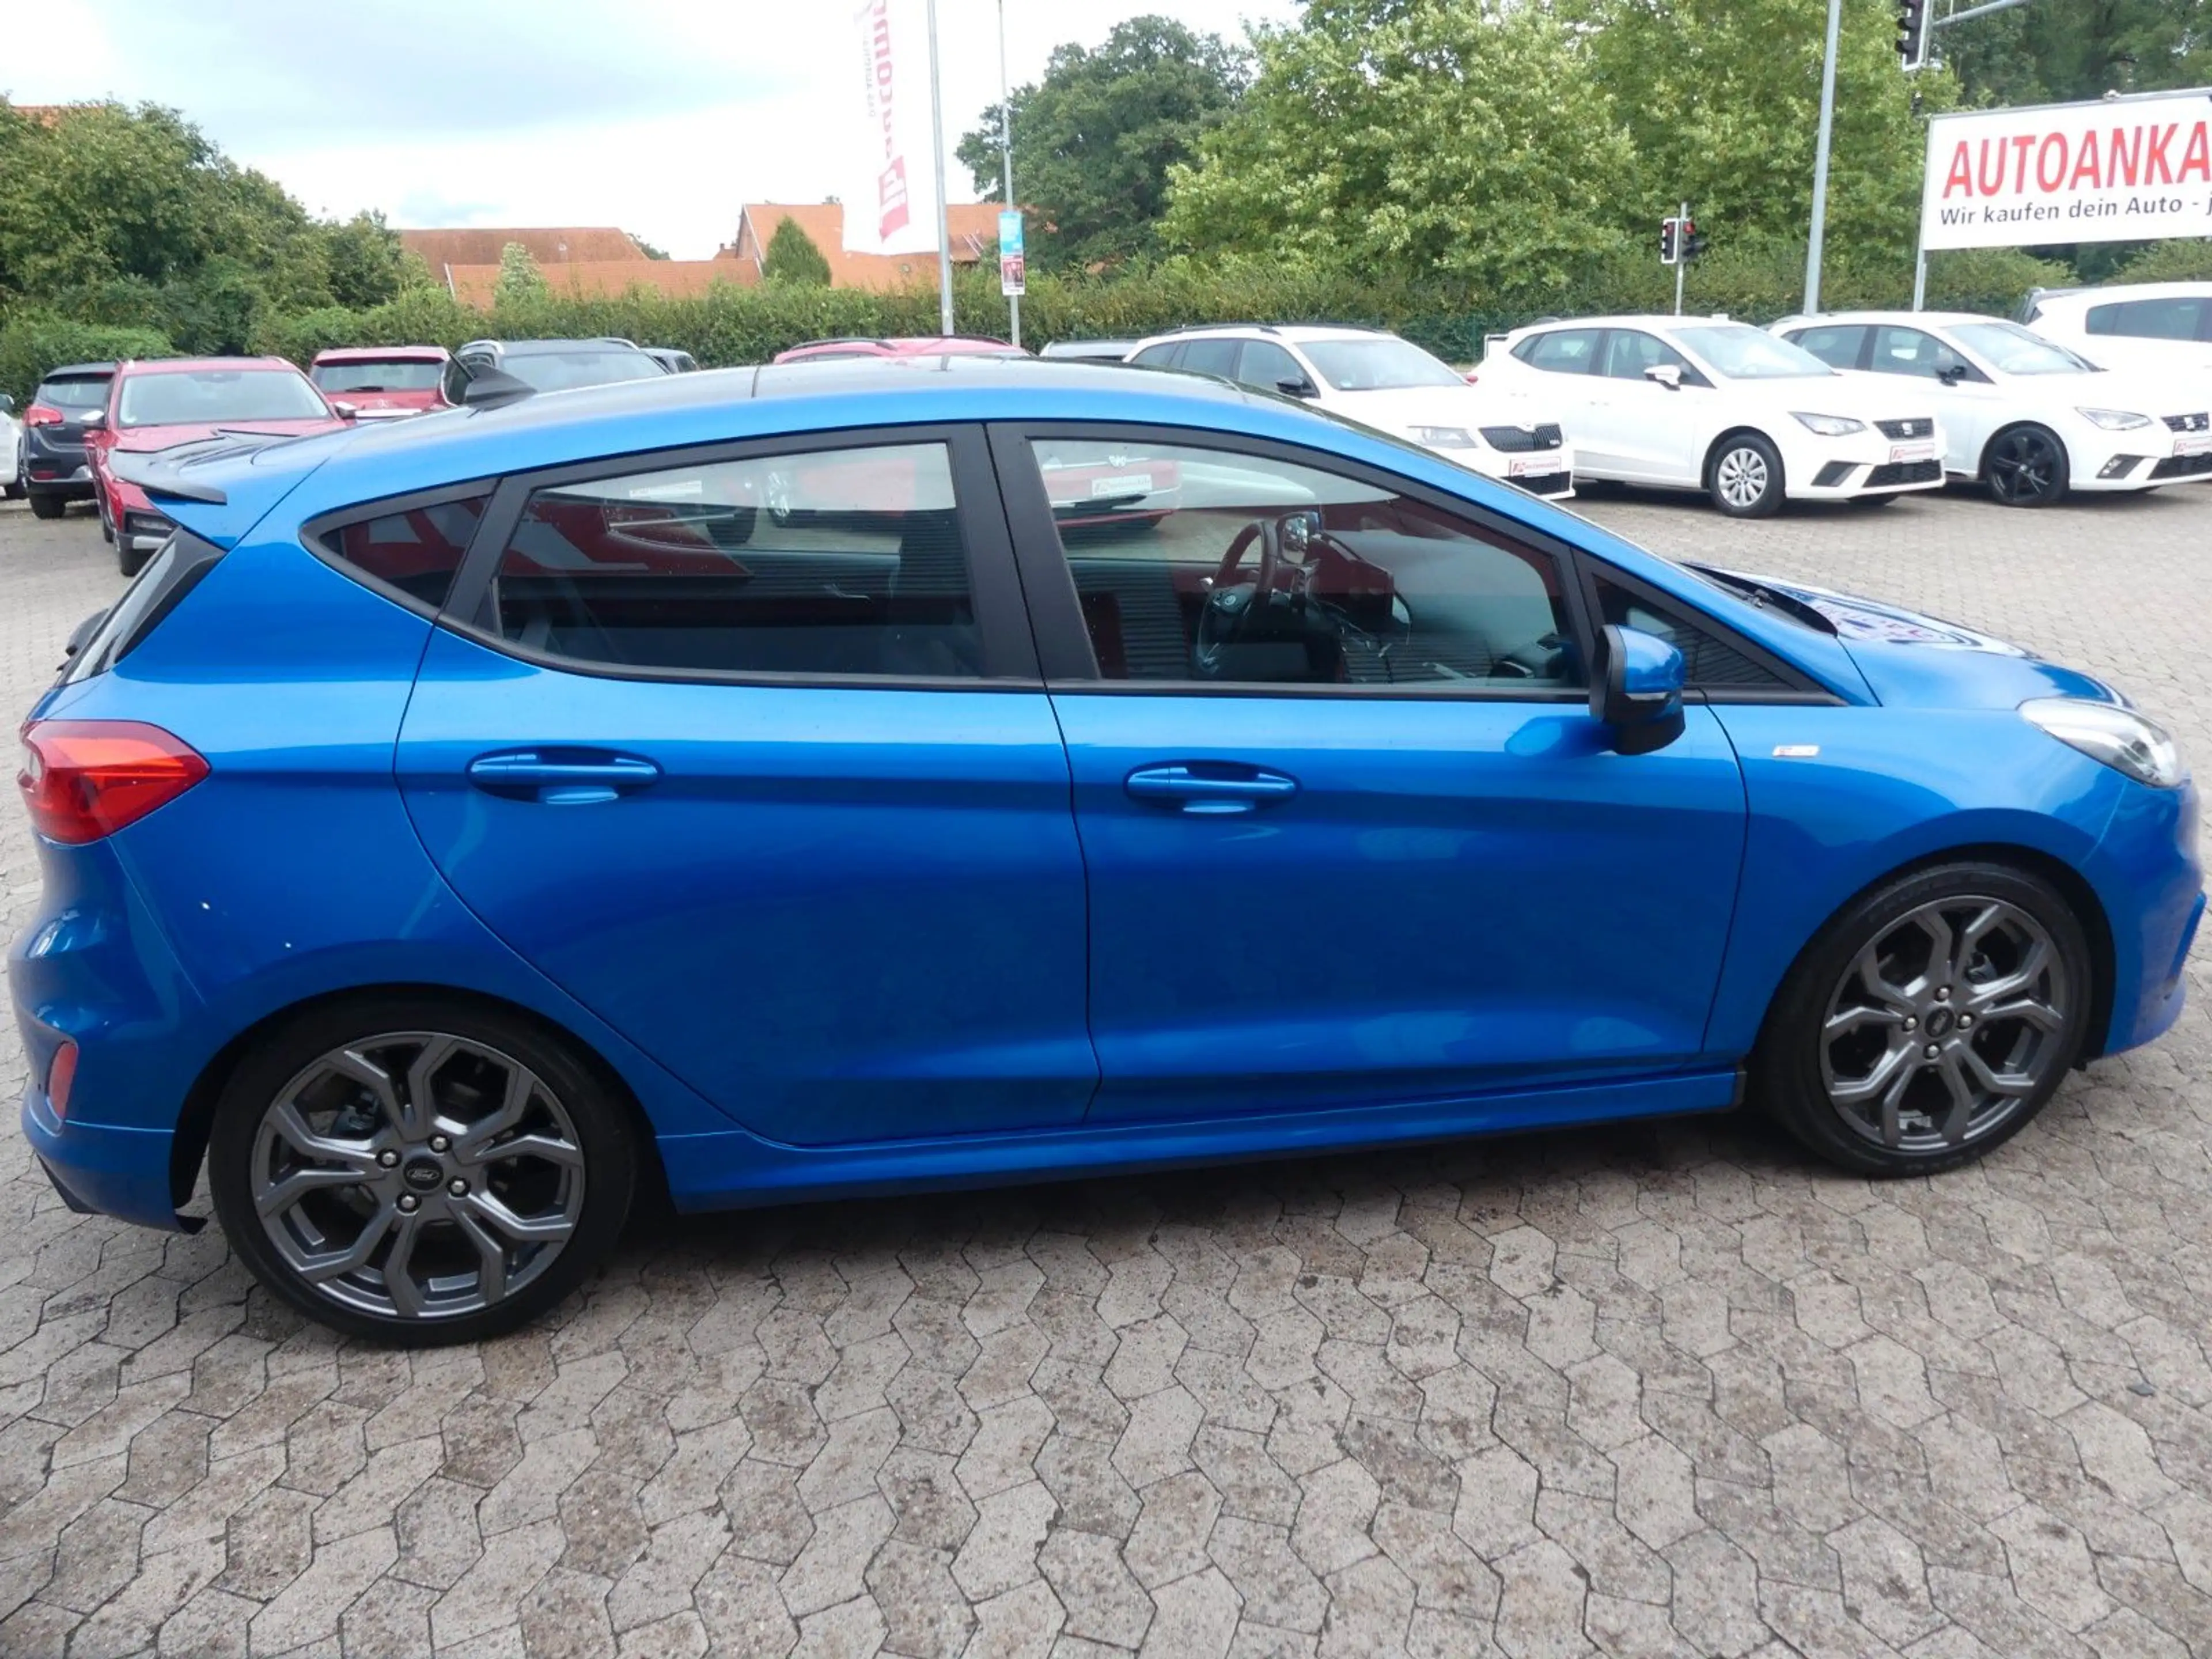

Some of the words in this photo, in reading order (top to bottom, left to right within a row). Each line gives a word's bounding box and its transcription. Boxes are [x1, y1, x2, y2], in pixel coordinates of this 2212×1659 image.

[1942, 121, 2212, 199] AUTOANKA
[1941, 208, 1976, 225] Wir
[1983, 202, 2059, 222] kaufen
[2069, 197, 2118, 218] dein
[2126, 196, 2182, 215] Auto
